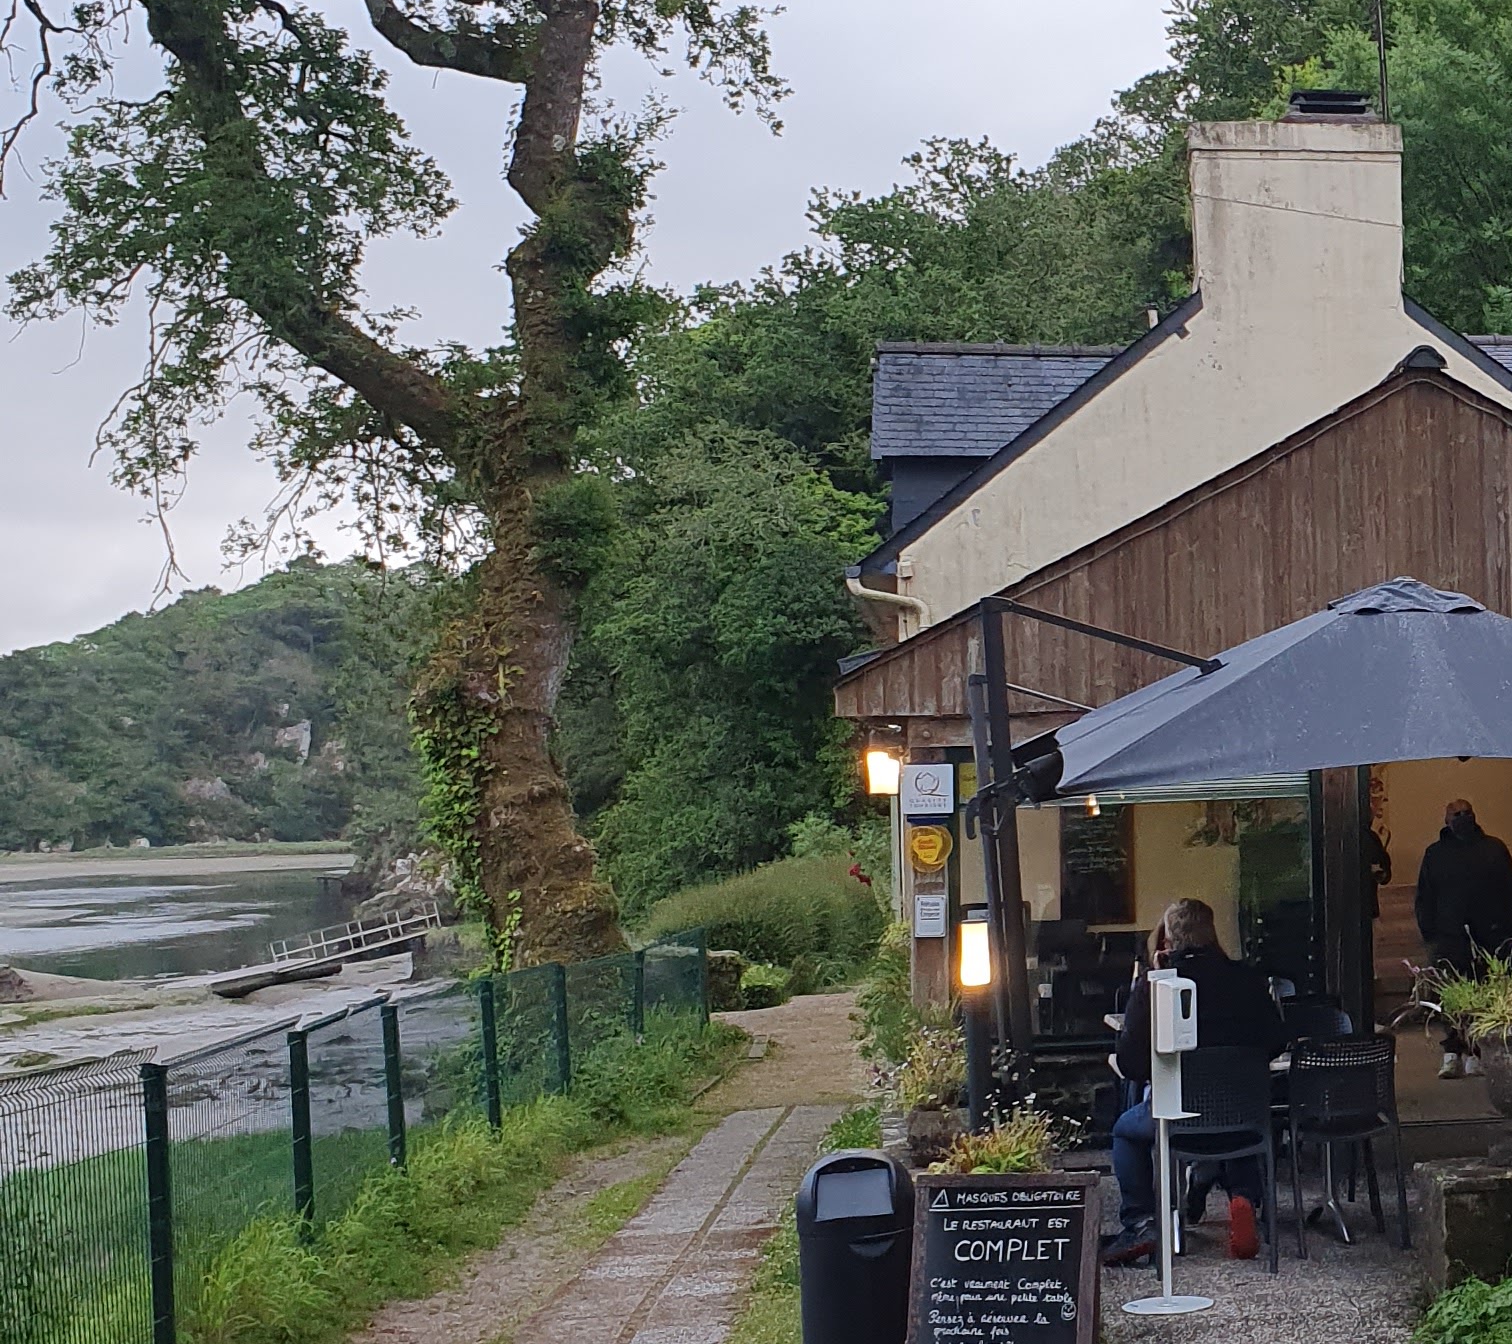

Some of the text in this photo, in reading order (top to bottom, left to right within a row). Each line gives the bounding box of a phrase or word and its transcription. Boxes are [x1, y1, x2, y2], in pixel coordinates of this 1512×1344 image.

[956, 1190, 1081, 1205] MASQUES OBLIGATOIRE
[943, 1218, 1070, 1231] LE RESTAURANT EST
[954, 1238, 1071, 1263] COMPLET
[964, 1279, 1011, 1290] vraiment
[985, 1292, 1007, 1302] une
[1011, 1292, 1038, 1305] petite
[1042, 1292, 1075, 1304] table
[928, 1309, 1050, 1328] Pensez à réserver la
[933, 1325, 1010, 1340] prochaine fois
